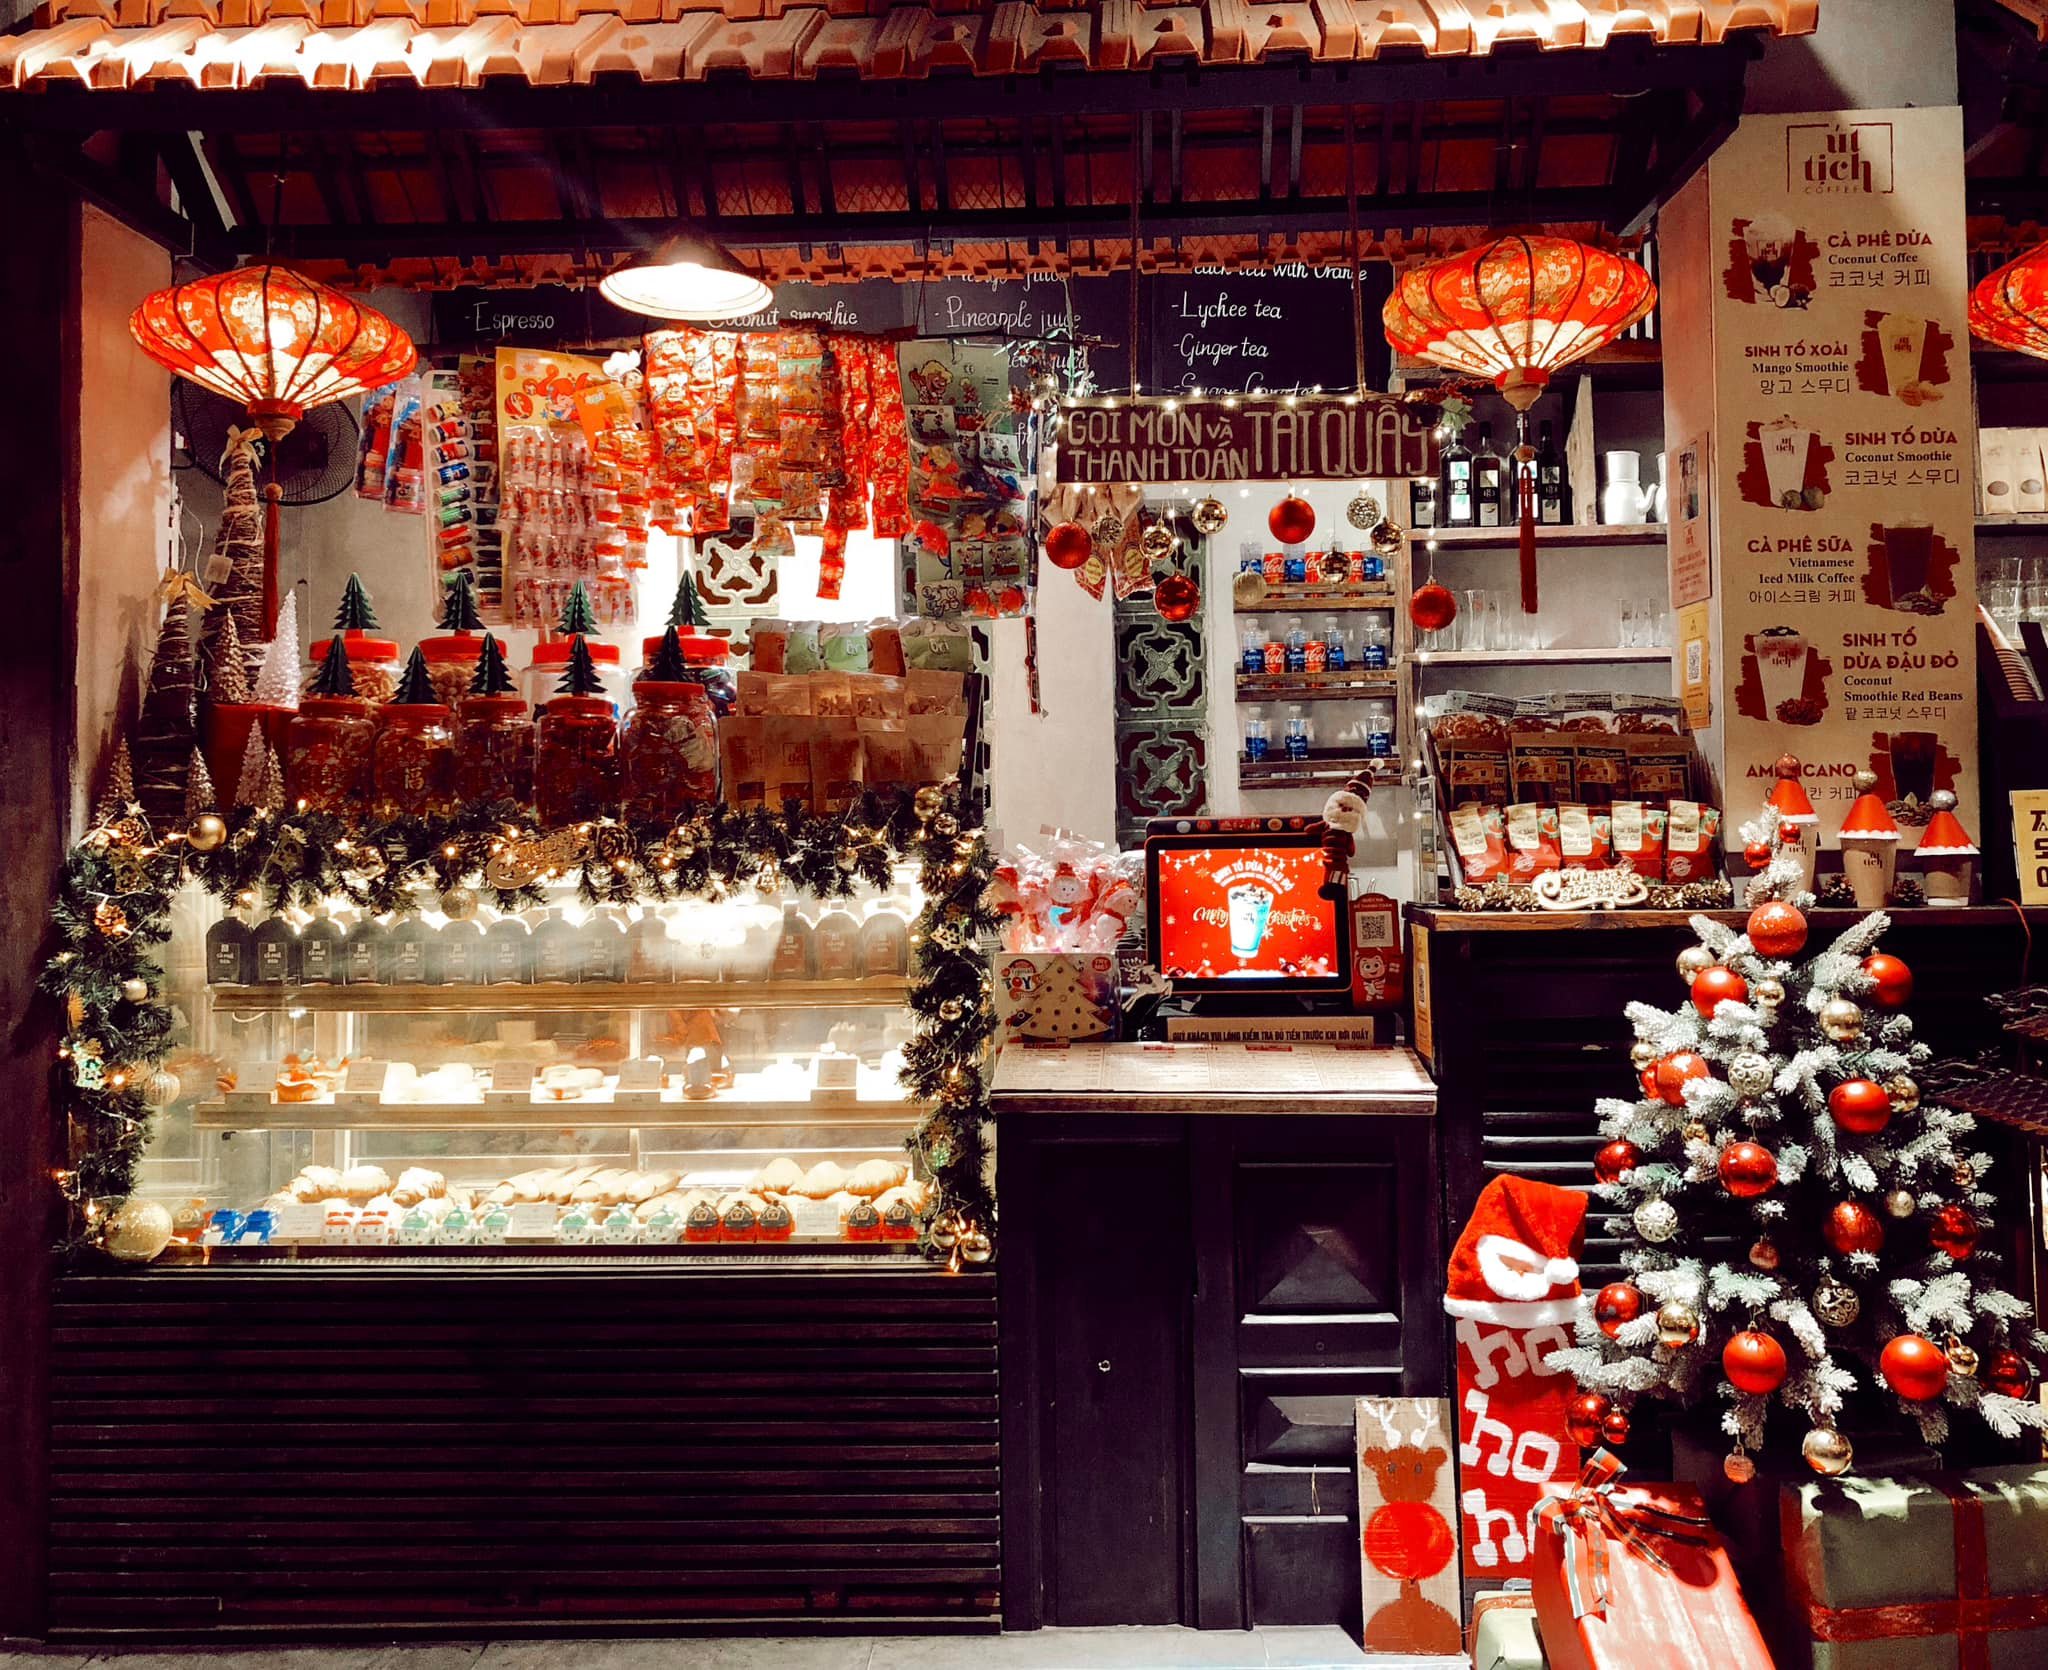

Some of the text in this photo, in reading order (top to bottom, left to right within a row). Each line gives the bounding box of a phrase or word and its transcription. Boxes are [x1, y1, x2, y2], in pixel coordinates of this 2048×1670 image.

[1857, 229, 1891, 247] PHÊ
[1828, 252, 1918, 265] Coconut Coffee
[1828, 269, 1930, 287] 코코넛 커피
[1254, 299, 1282, 319] tea
[1241, 336, 1269, 357] tea
[1744, 339, 1848, 358] SINH TỐ XOÀI
[1752, 361, 1849, 375] Mango Smoothie
[1760, 378, 1850, 395] 망고 스무디
[1067, 411, 1122, 449] GỌI
[1844, 432, 1886, 446] SINH
[1890, 425, 1916, 445] TỐ
[1243, 410, 1314, 479] TẠI
[1067, 440, 1249, 481] THANH TOÁN
[1845, 450, 1952, 463] Coconut Smoothie
[1844, 468, 1960, 486] 코코넛 스무디
[1777, 534, 1813, 553] PHÊ
[1817, 535, 1853, 552] SỮA
[1789, 557, 1855, 568] Vietnamese
[1759, 572, 1855, 584] Iced Milk Coffee
[1749, 589, 1856, 604] 아이스크림 커피
[1842, 626, 1918, 647] SINH TỐ
[1886, 651, 1926, 673] ĐẬU
[1930, 650, 1959, 669] ĐỎ
[1844, 675, 1893, 686] Coconut
[1844, 690, 1964, 702] Smoothie Red Beans
[1862, 706, 1902, 720] 코코넛
[1906, 706, 1946, 720] 스무디
[1456, 1318, 1571, 1391] ho
[1459, 1388, 1560, 1482] ho
[1462, 1487, 1535, 1567] h
